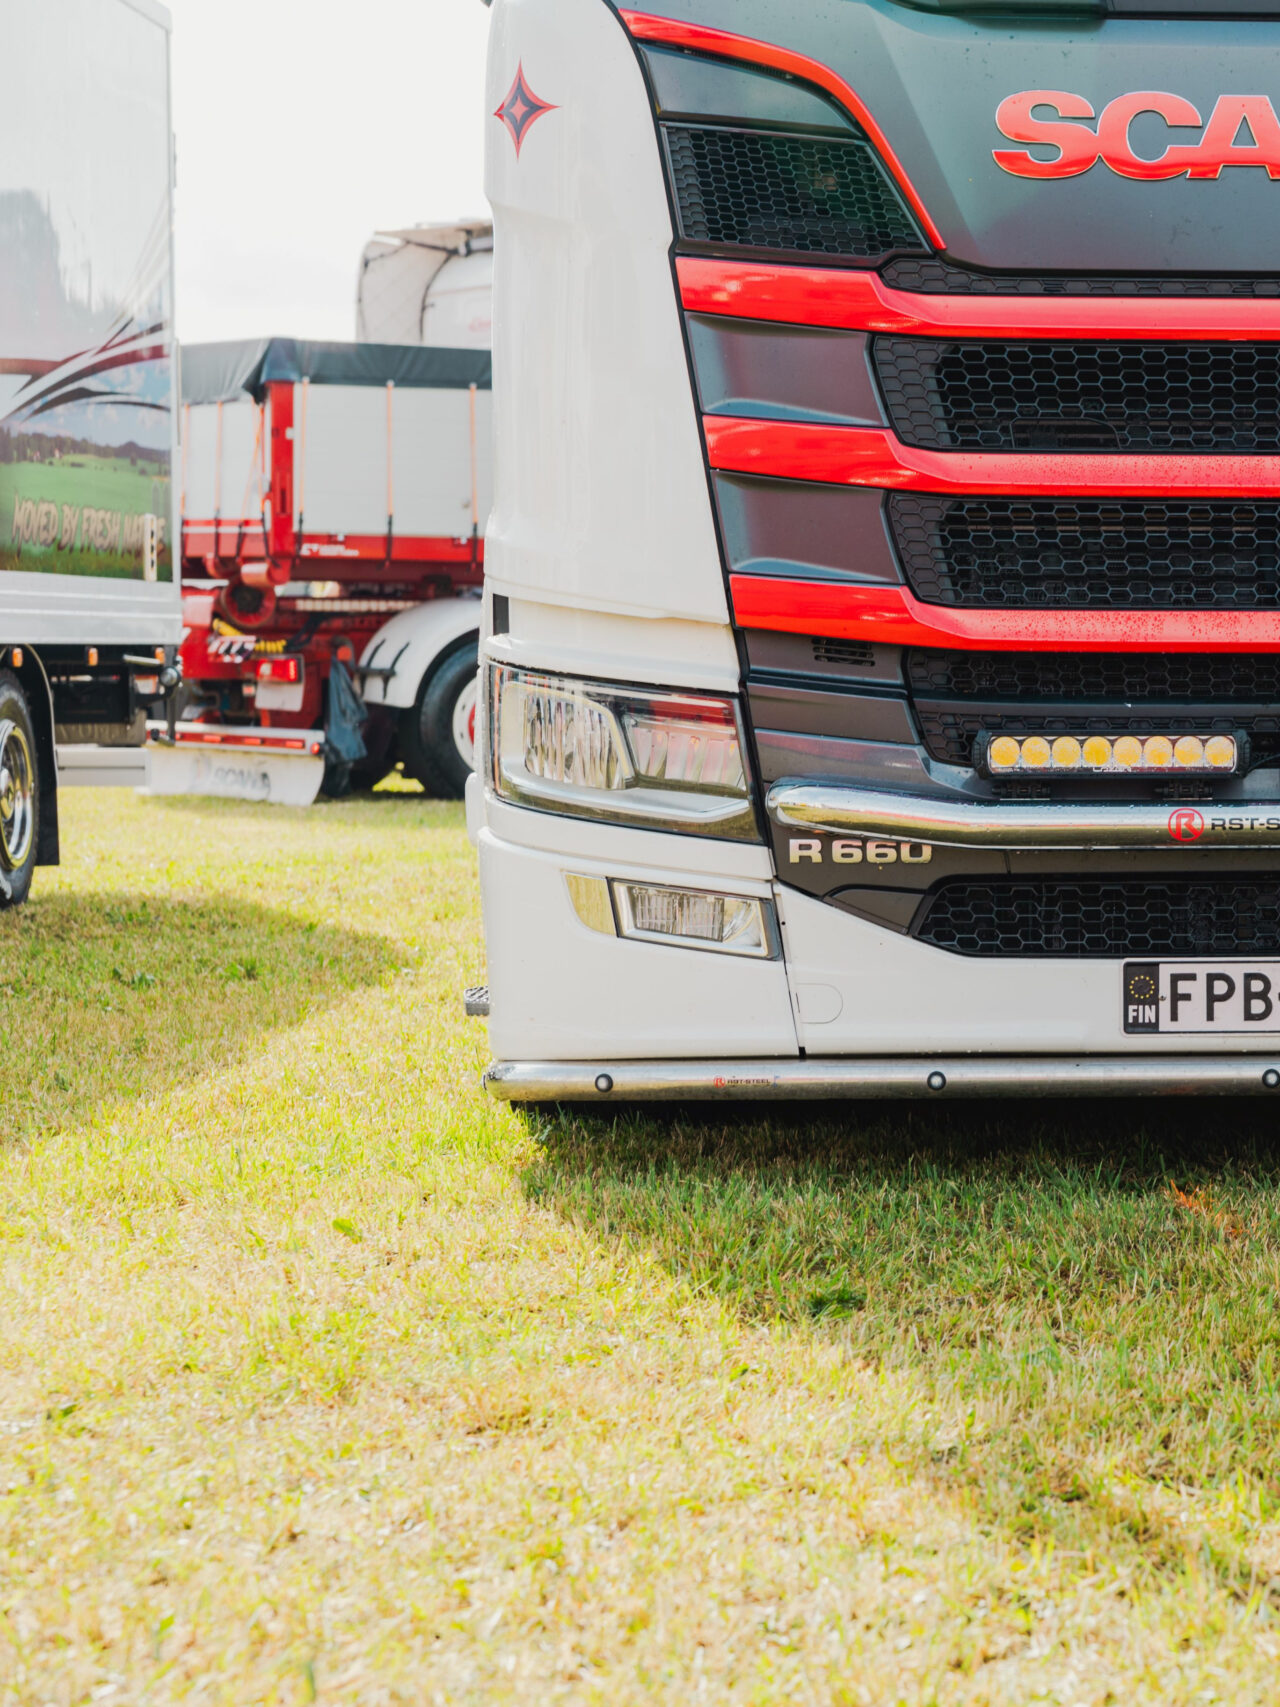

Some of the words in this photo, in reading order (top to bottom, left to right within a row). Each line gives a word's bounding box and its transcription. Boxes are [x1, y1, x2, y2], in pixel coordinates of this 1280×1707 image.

[11, 488, 59, 559] MOVED
[58, 503, 80, 554] BY
[80, 505, 122, 556] FRESH
[121, 512, 167, 558] NATE
[789, 838, 823, 864] R
[831, 838, 932, 864] 660
[1127, 1004, 1157, 1024] FIN
